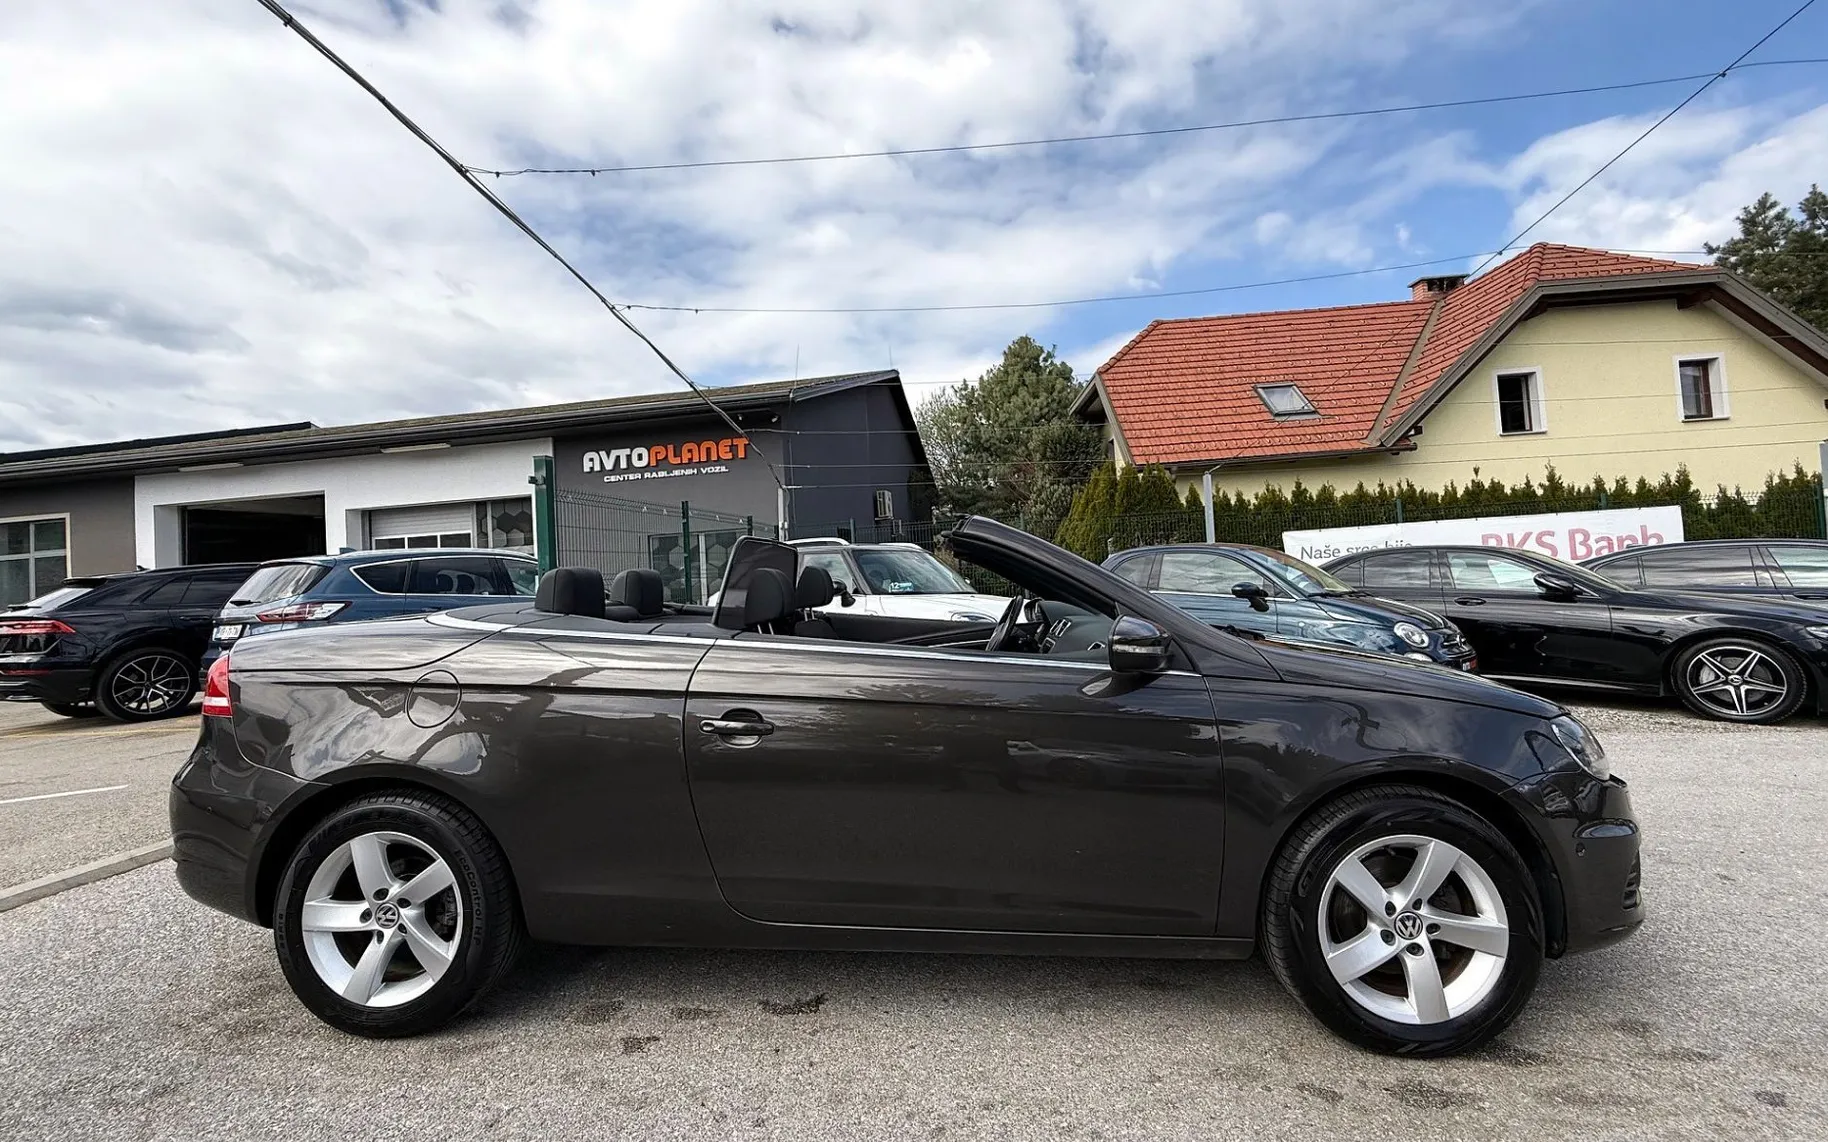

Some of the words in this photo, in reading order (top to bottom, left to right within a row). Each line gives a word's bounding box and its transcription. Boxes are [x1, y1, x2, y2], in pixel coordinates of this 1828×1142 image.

[583, 437, 749, 473] AVTOPLANET
[603, 474, 642, 484] CENTER
[644, 468, 698, 480] RABLJENIH
[700, 466, 729, 475] VOZIL
[1301, 545, 1341, 561] Naše
